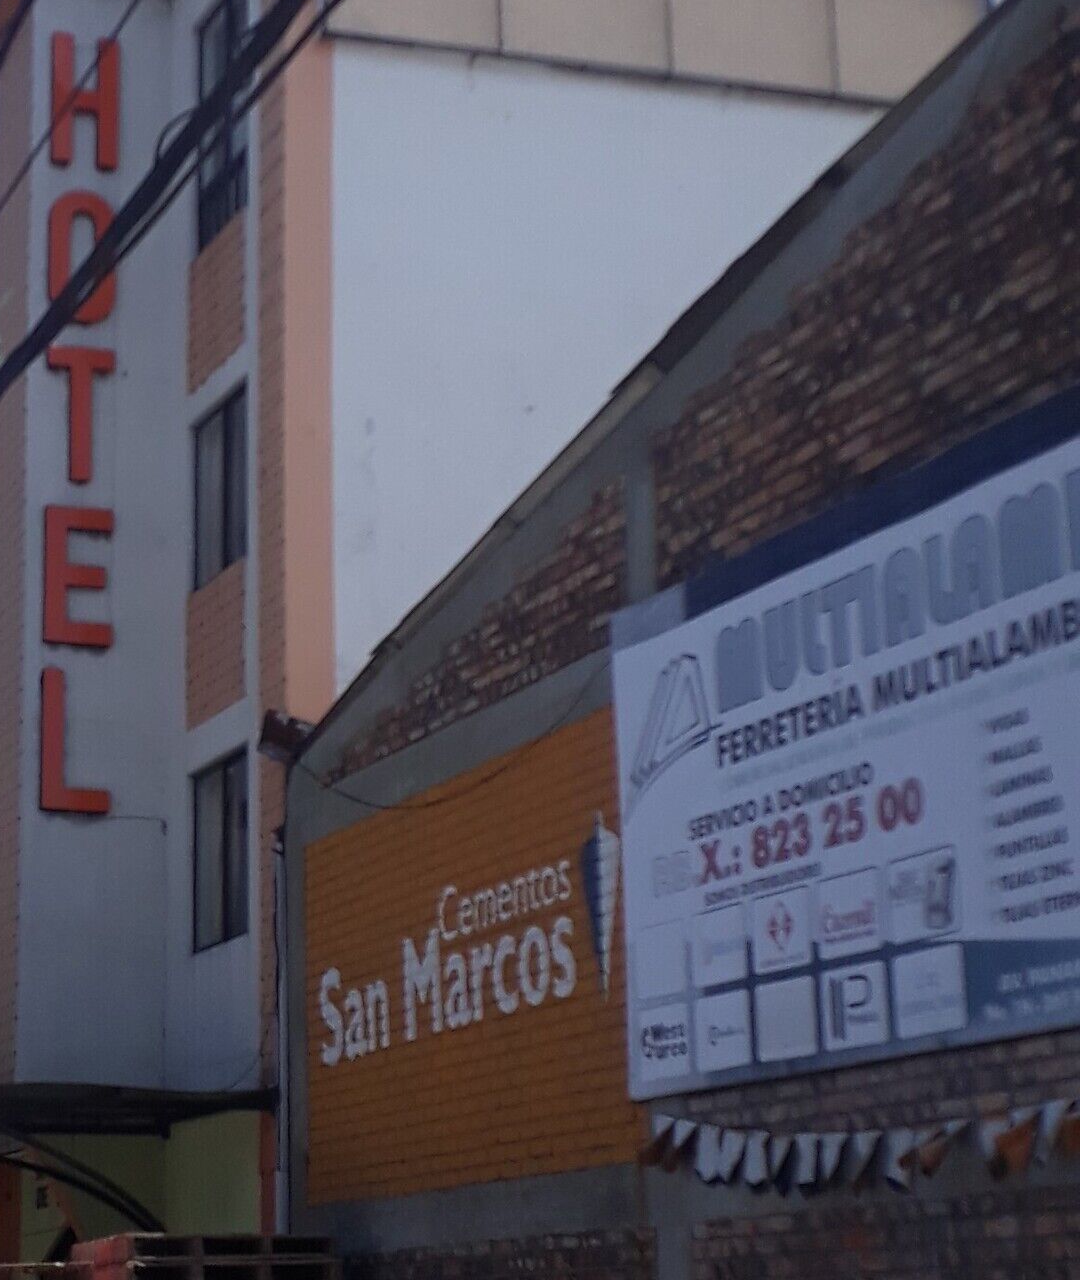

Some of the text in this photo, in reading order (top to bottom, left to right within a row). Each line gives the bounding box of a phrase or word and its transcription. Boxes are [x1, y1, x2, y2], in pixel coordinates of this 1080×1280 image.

[39, 31, 118, 814] HOTEL
[689, 762, 874, 841] SERVICIO A DOMICILIO
[751, 812, 812, 868] 823
[823, 794, 866, 849] 25
[876, 776, 926, 832] 00
[438, 859, 571, 941] Cementos
[320, 916, 578, 1066] San Marcos
